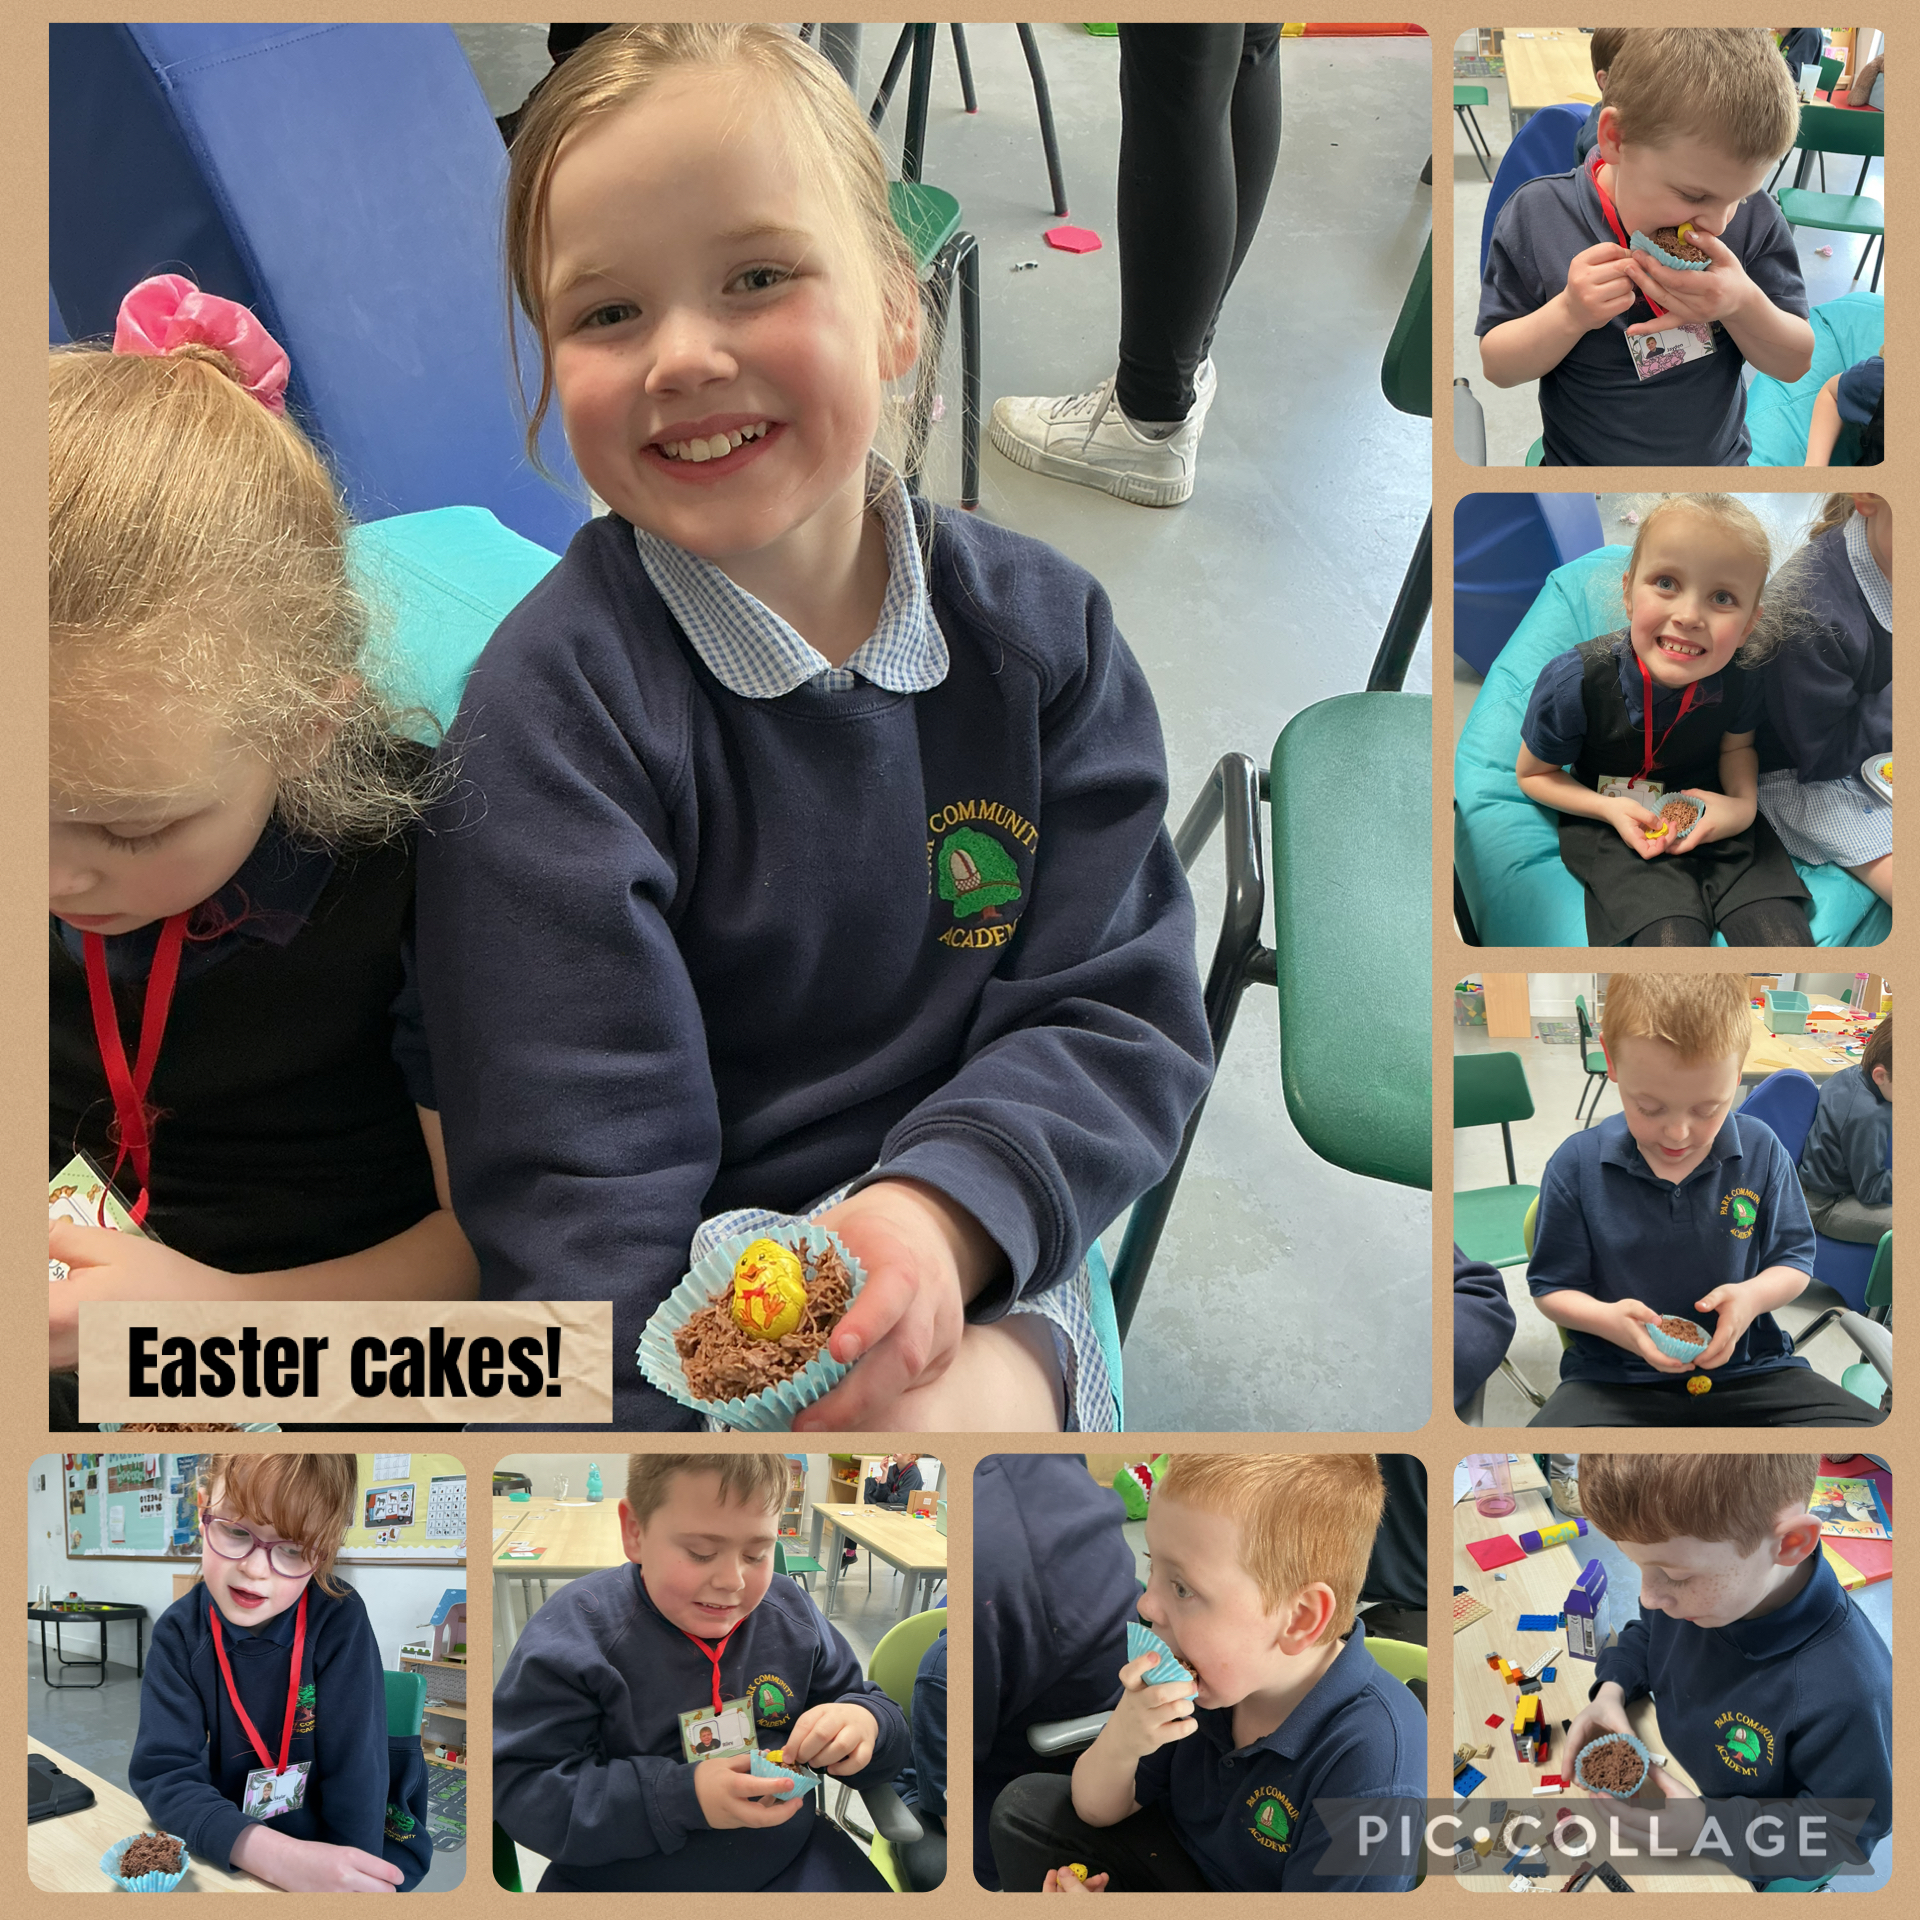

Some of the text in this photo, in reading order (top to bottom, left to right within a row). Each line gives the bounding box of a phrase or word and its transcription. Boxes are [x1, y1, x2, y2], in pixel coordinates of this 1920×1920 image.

[937, 913, 1023, 948] ACADEM
[1720, 1187, 1760, 1215] PARK COMMUN
[1730, 1225, 1754, 1239] ACADEMY
[745, 1674, 794, 1698] RK COMMUNITY
[756, 1713, 791, 1728] ACADEMY
[1714, 1711, 1774, 1766] PARK COMMUNITY
[1715, 1744, 1758, 1777] ACADEMY
[1265, 1785, 1300, 1822] COMMUN
